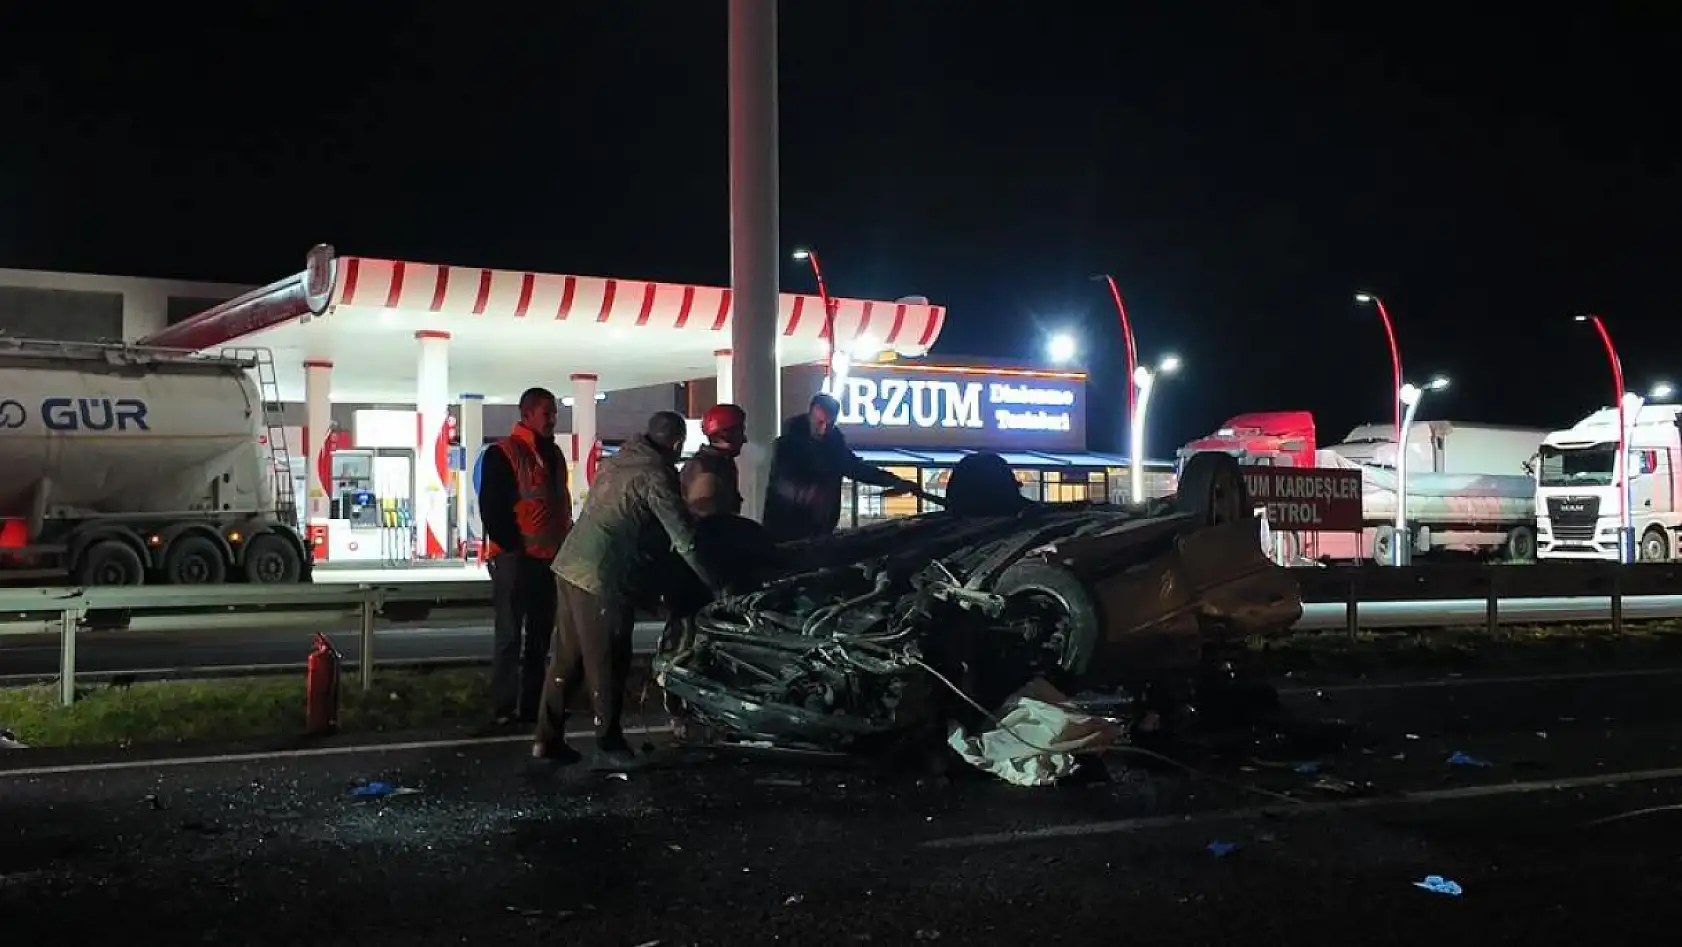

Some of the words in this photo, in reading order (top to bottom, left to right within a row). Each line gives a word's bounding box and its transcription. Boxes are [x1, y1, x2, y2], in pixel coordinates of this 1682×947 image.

[41, 398, 150, 431] GÜR
[1243, 474, 1270, 497] UM
[1275, 475, 1359, 504] KARDEŞLER
